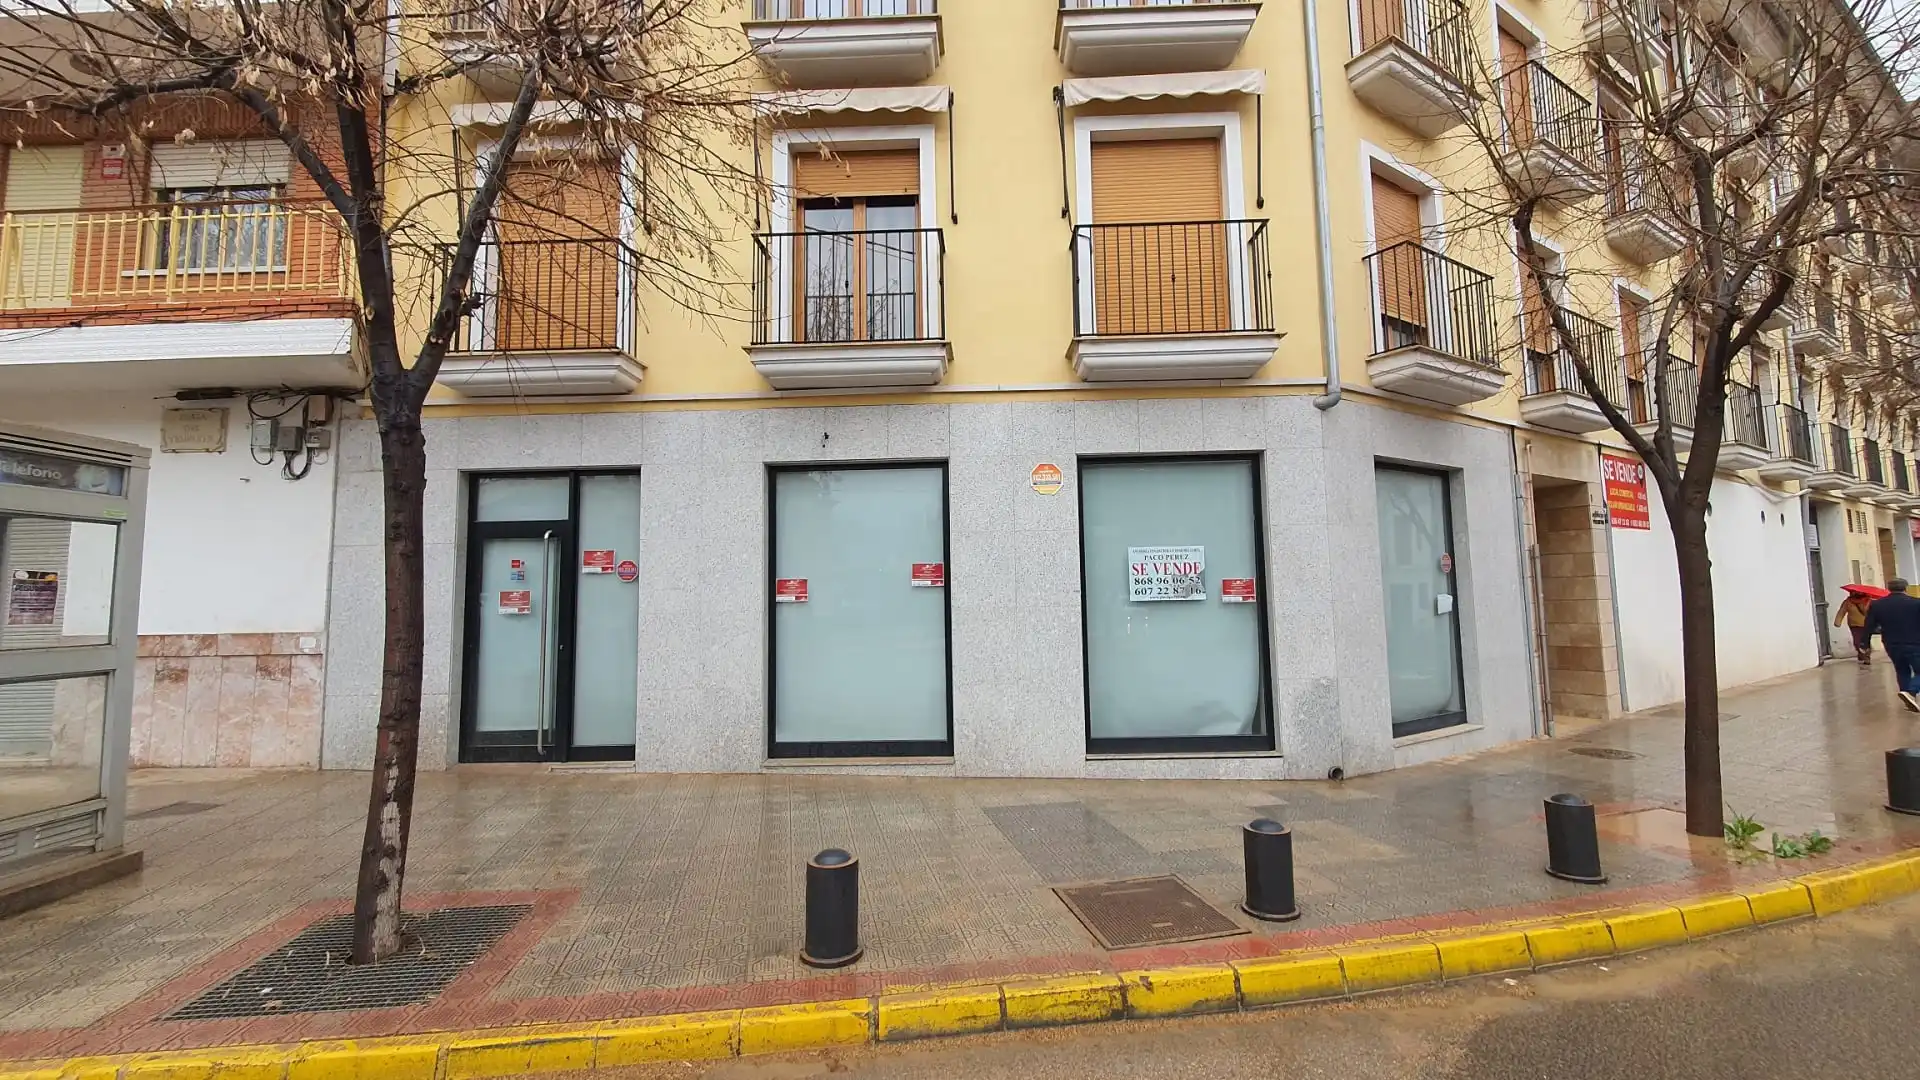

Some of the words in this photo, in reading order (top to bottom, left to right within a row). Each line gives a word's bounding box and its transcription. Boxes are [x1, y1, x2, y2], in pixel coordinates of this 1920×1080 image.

[1604, 459, 1615, 480] SE
[1615, 461, 1637, 484] VENDE
[1132, 562, 1149, 576] SE
[1153, 561, 1201, 576] VENDE
[1134, 577, 1153, 586] 868
[1156, 577, 1169, 585] 96
[1172, 576, 1185, 585] 06
[1134, 587, 1153, 596] 607
[1156, 587, 1169, 595] 22
